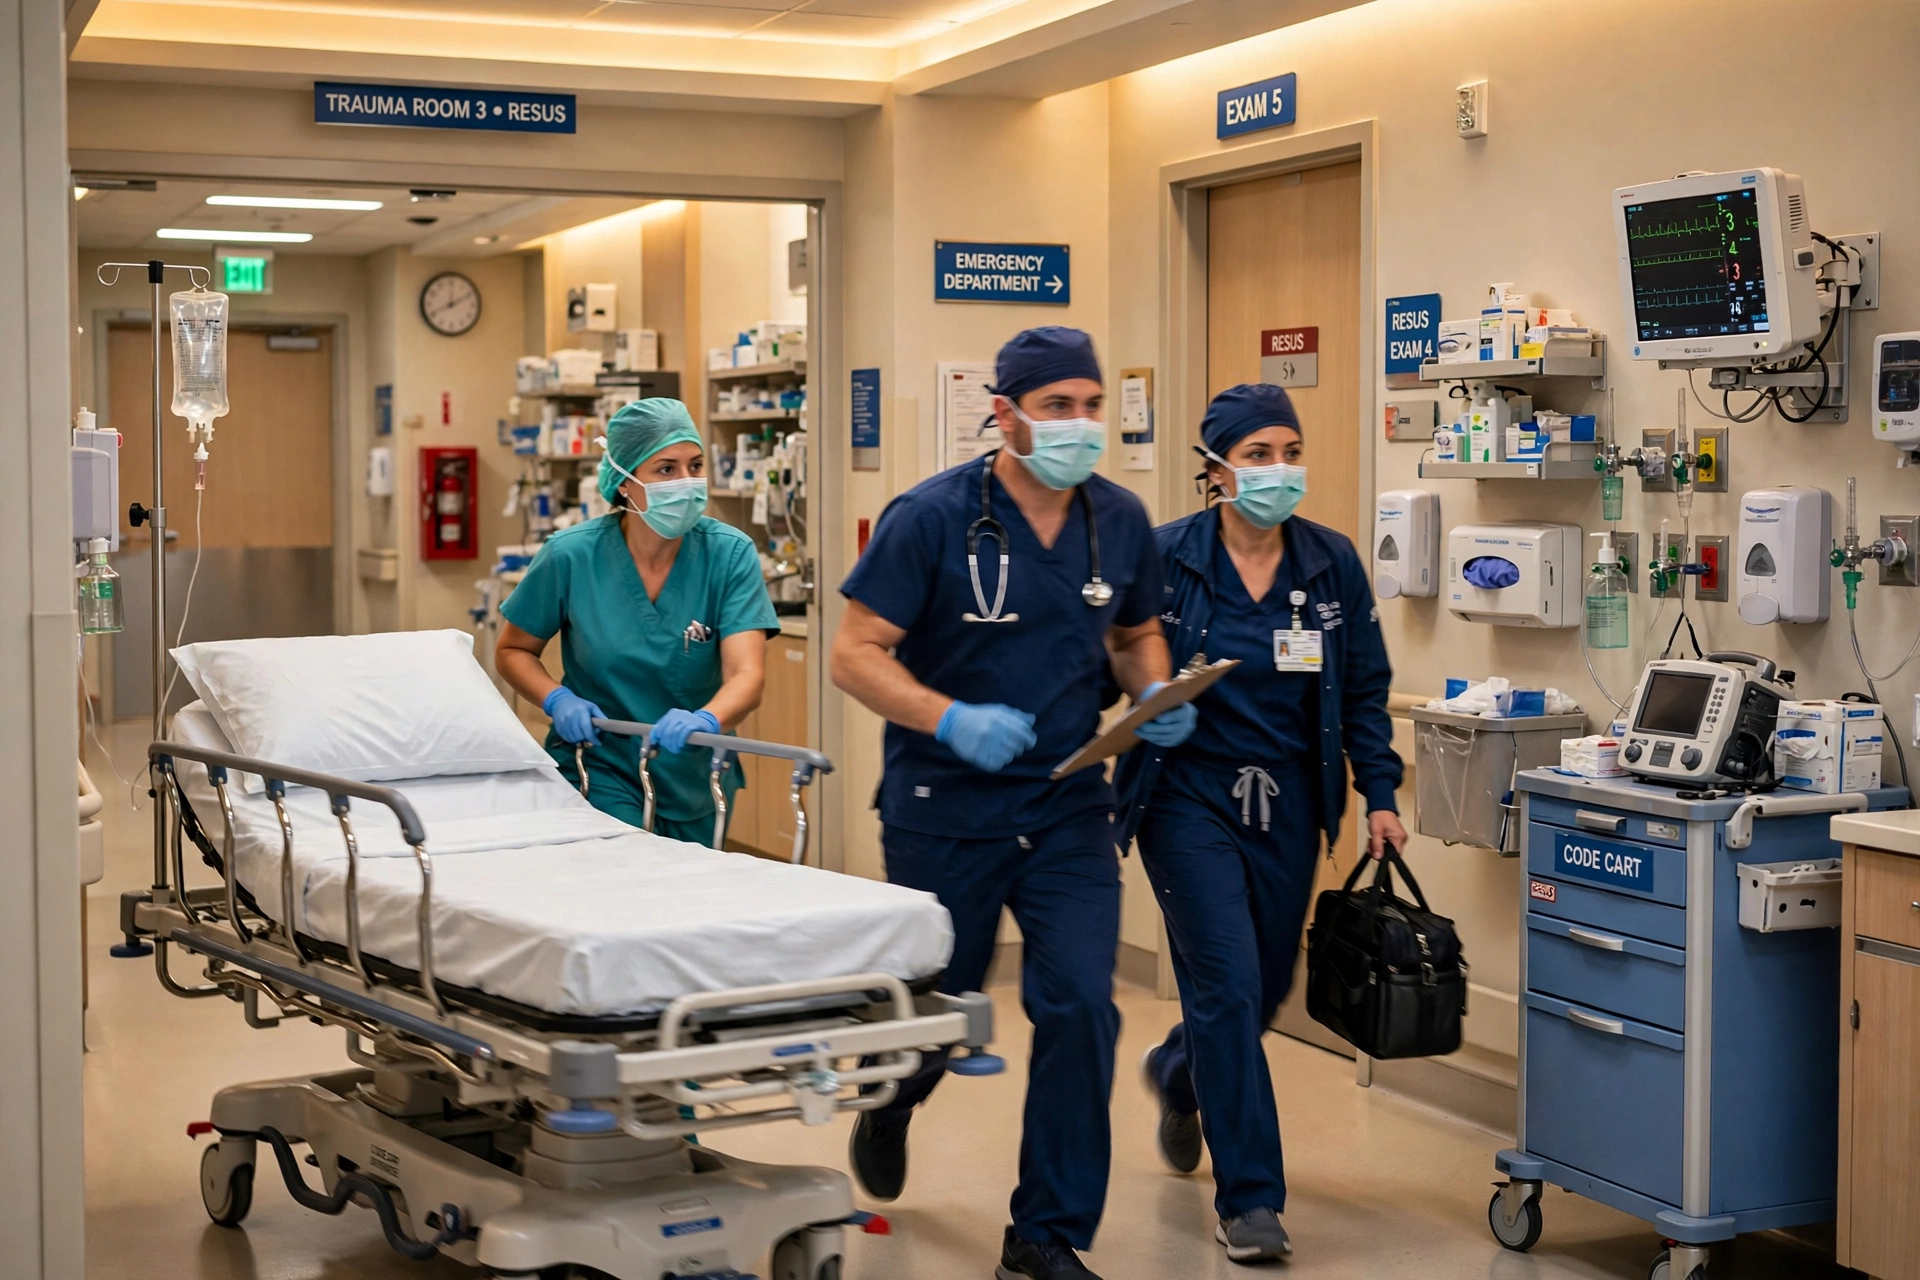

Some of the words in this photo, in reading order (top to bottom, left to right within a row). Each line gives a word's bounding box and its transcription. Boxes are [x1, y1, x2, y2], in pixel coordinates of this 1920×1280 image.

[326, 93, 408, 115] TRAUMA
[413, 97, 470, 119] ROOM
[475, 100, 487, 119] 3
[508, 102, 566, 123] RESUS
[1226, 91, 1267, 125] EXAM
[1272, 88, 1282, 115] 5
[955, 252, 1044, 271] EMERGENCY
[944, 273, 1041, 292] DEPARTMENT
[1392, 310, 1429, 331] RESUS
[1271, 333, 1304, 352] RESUS
[1390, 340, 1423, 360] EXAM
[1424, 339, 1433, 357] 4
[1563, 844, 1601, 870] CODE
[1604, 852, 1642, 878] CART
